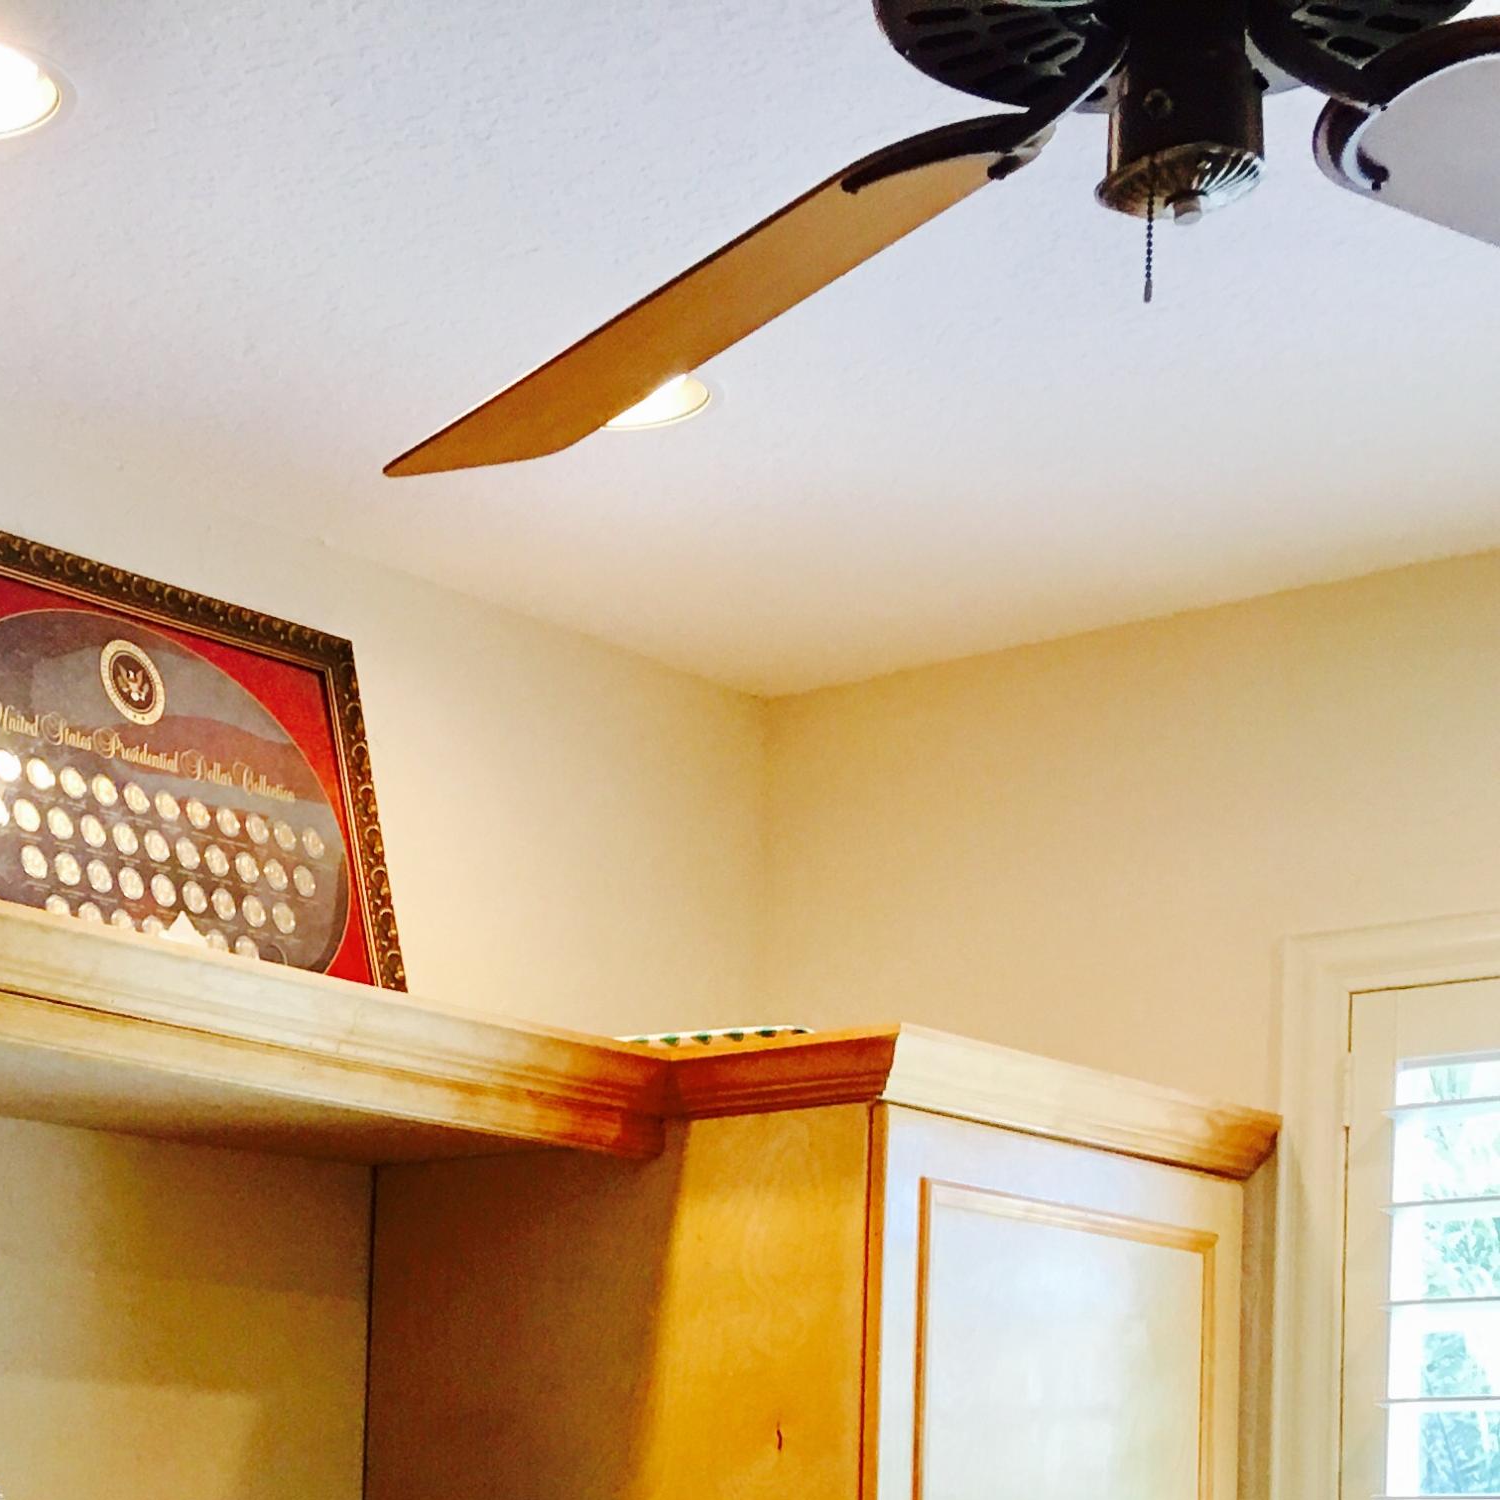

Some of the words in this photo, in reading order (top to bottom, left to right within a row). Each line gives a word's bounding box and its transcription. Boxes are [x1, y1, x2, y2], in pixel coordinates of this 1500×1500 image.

[41, 711, 94, 751] States
[93, 726, 180, 774] Presidential
[180, 749, 235, 783] Dollar
[233, 761, 297, 803] Collection
